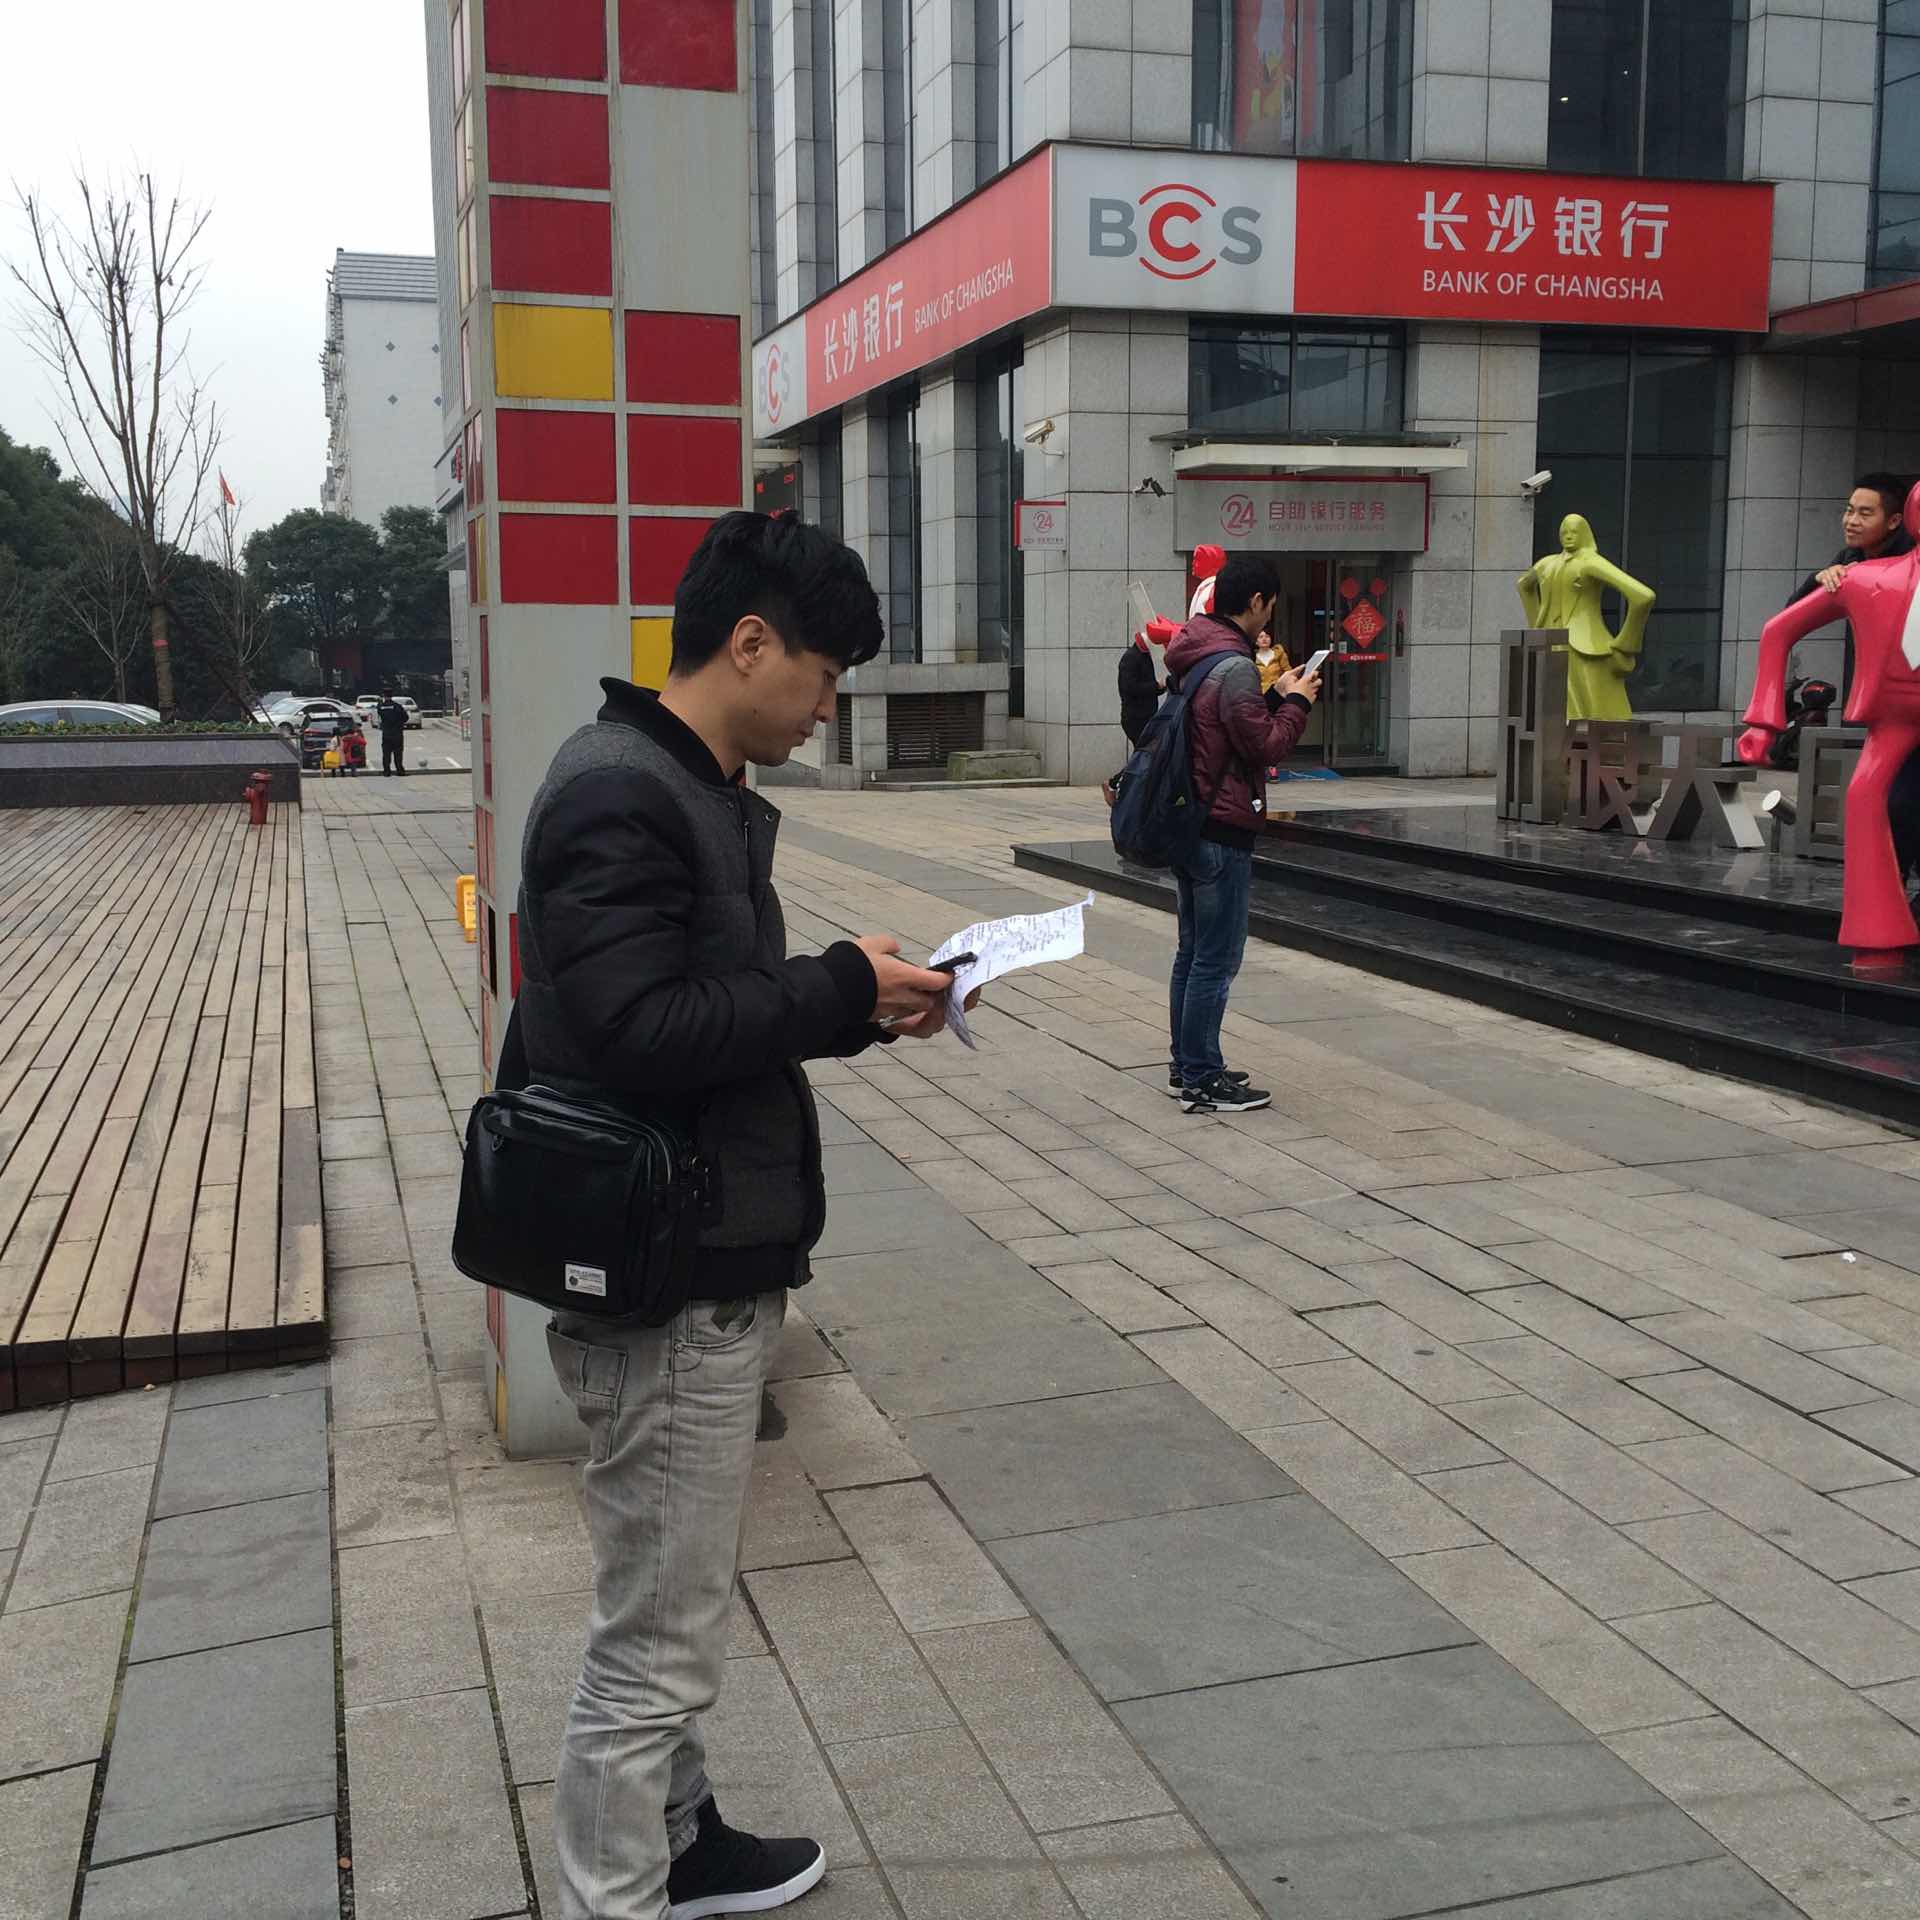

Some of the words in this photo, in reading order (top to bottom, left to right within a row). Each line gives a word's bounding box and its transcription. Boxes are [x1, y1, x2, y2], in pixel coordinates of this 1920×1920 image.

[1089, 197, 1262, 266] BCS
[1417, 190, 1670, 261] 长沙银行
[913, 300, 940, 334] BANK
[941, 290, 955, 321] OF
[955, 257, 1015, 312] CHANGSHA
[1422, 269, 1488, 295] BANK
[1495, 272, 1528, 297] OF
[1534, 274, 1664, 303] CHANGSHA
[823, 280, 904, 385] 长沙银行
[758, 352, 791, 414] BCS
[1036, 512, 1055, 529] 24
[1226, 500, 1257, 529] 24
[1268, 501, 1386, 521] 自助银行服务
